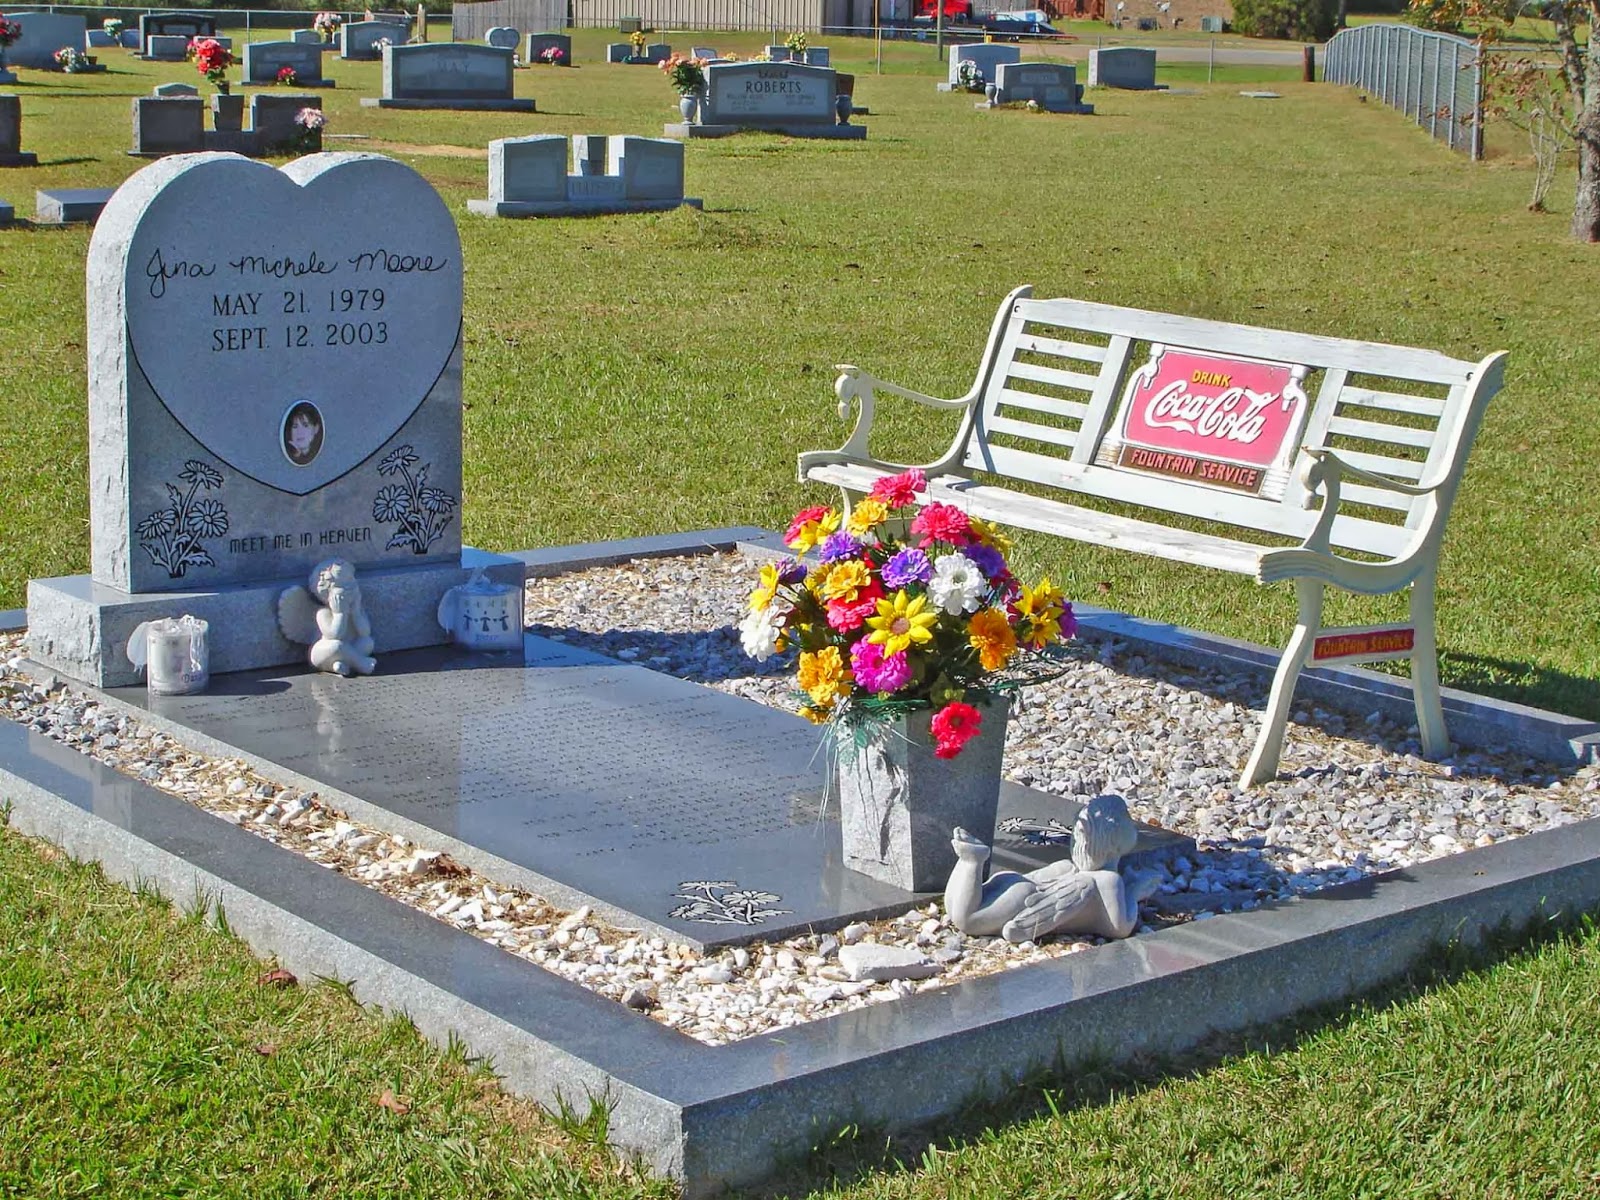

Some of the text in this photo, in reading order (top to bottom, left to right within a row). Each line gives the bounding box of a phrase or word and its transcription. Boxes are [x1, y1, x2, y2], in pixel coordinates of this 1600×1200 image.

[745, 81, 802, 93] ROBERTS
[229, 245, 338, 278] Michele
[349, 249, 448, 273] Moore
[212, 292, 263, 316] MAY
[329, 288, 385, 312] 1979
[326, 322, 388, 346] 2003
[1191, 369, 1231, 388] DRINK
[1130, 450, 1258, 486] FOUNTAIN SERVICE
[229, 527, 371, 553] MEET ME IN HEAVEN
